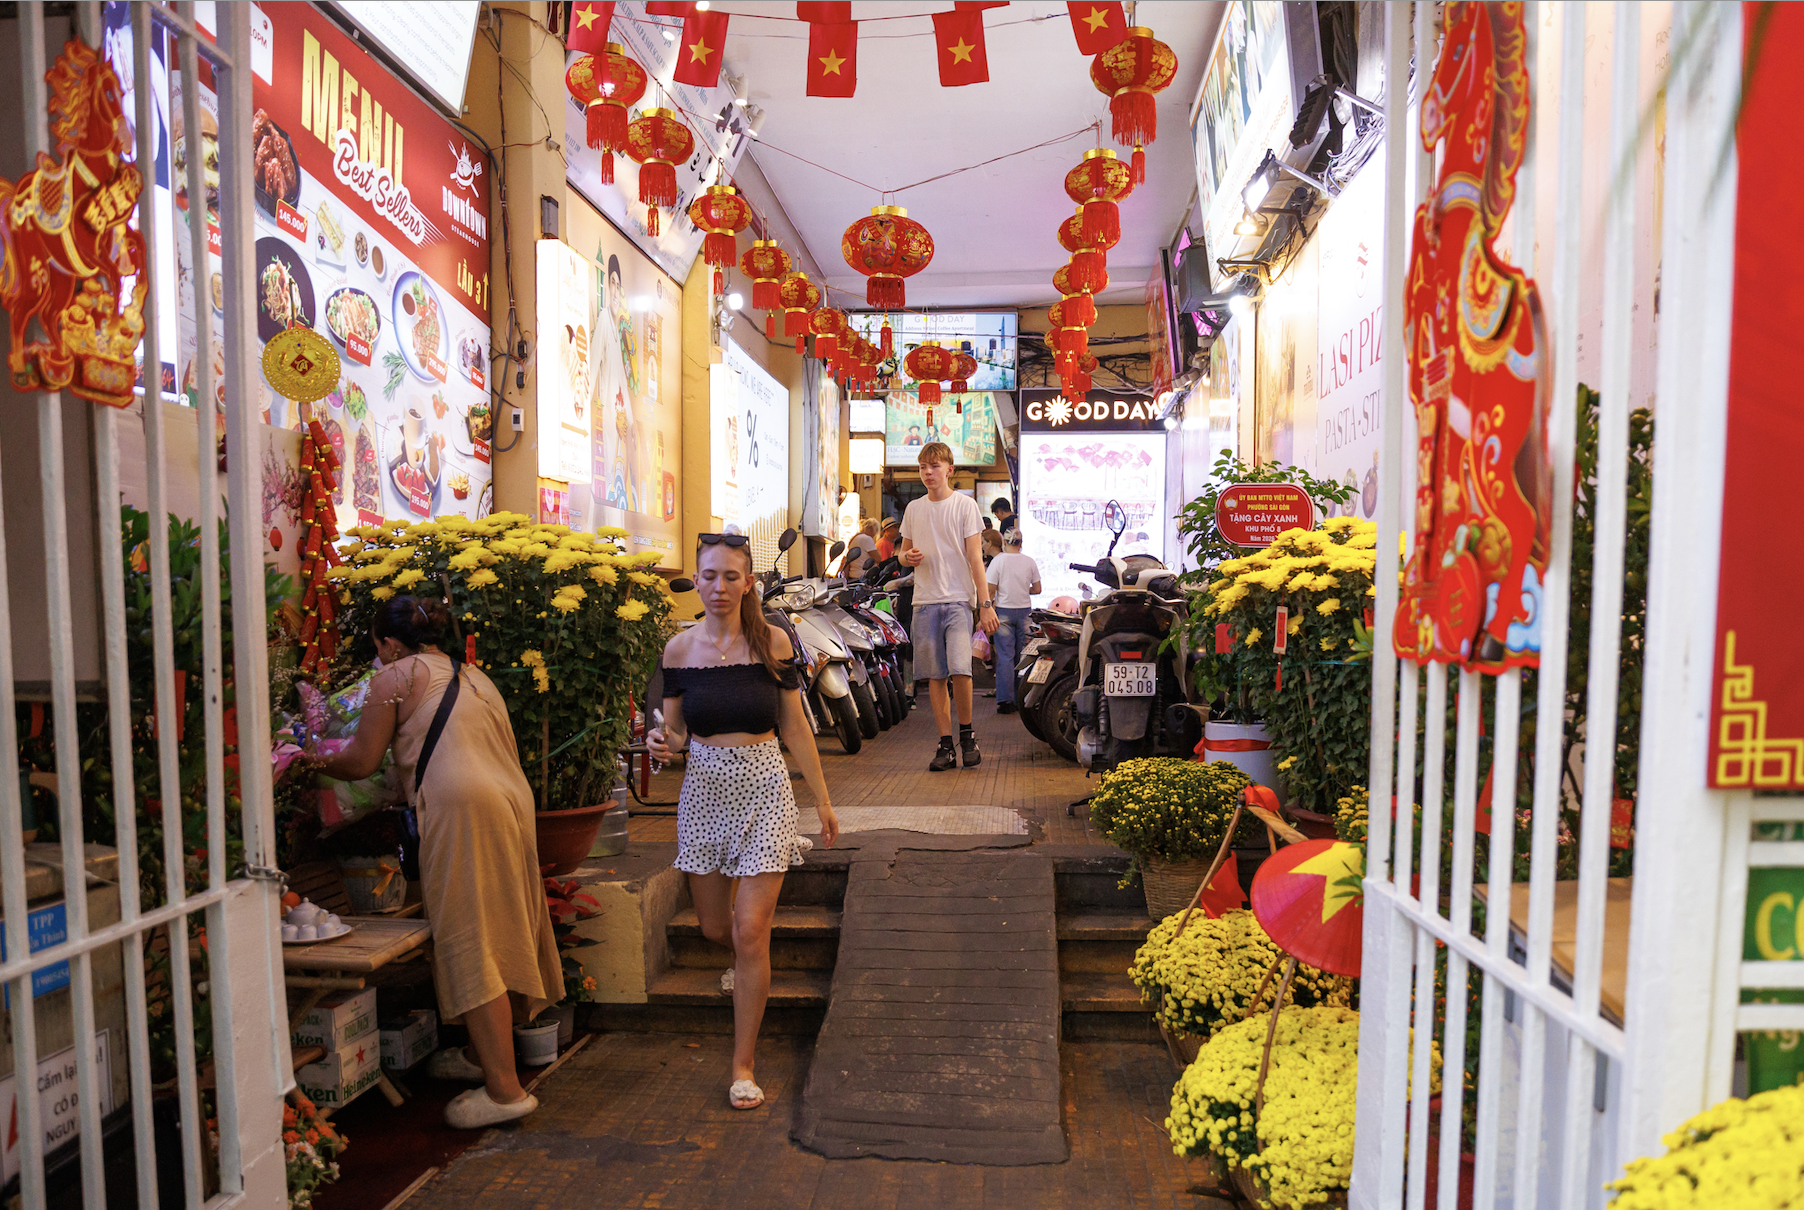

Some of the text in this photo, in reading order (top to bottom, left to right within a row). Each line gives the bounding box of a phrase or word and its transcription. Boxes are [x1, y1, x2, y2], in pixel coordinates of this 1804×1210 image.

[337, 137, 422, 237] Best Sellers
[278, 208, 305, 233] 145.000
[475, 280, 481, 305] 3
[349, 339, 369, 357] 95.000
[1114, 400, 1156, 421] DAY
[1229, 511, 1298, 525] TẶNG CÂY XANH
[1245, 525, 1259, 533] KHU
[1260, 523, 1275, 533] PHỐ
[1108, 680, 1153, 694] 045.08
[343, 1066, 381, 1101] Heineken
